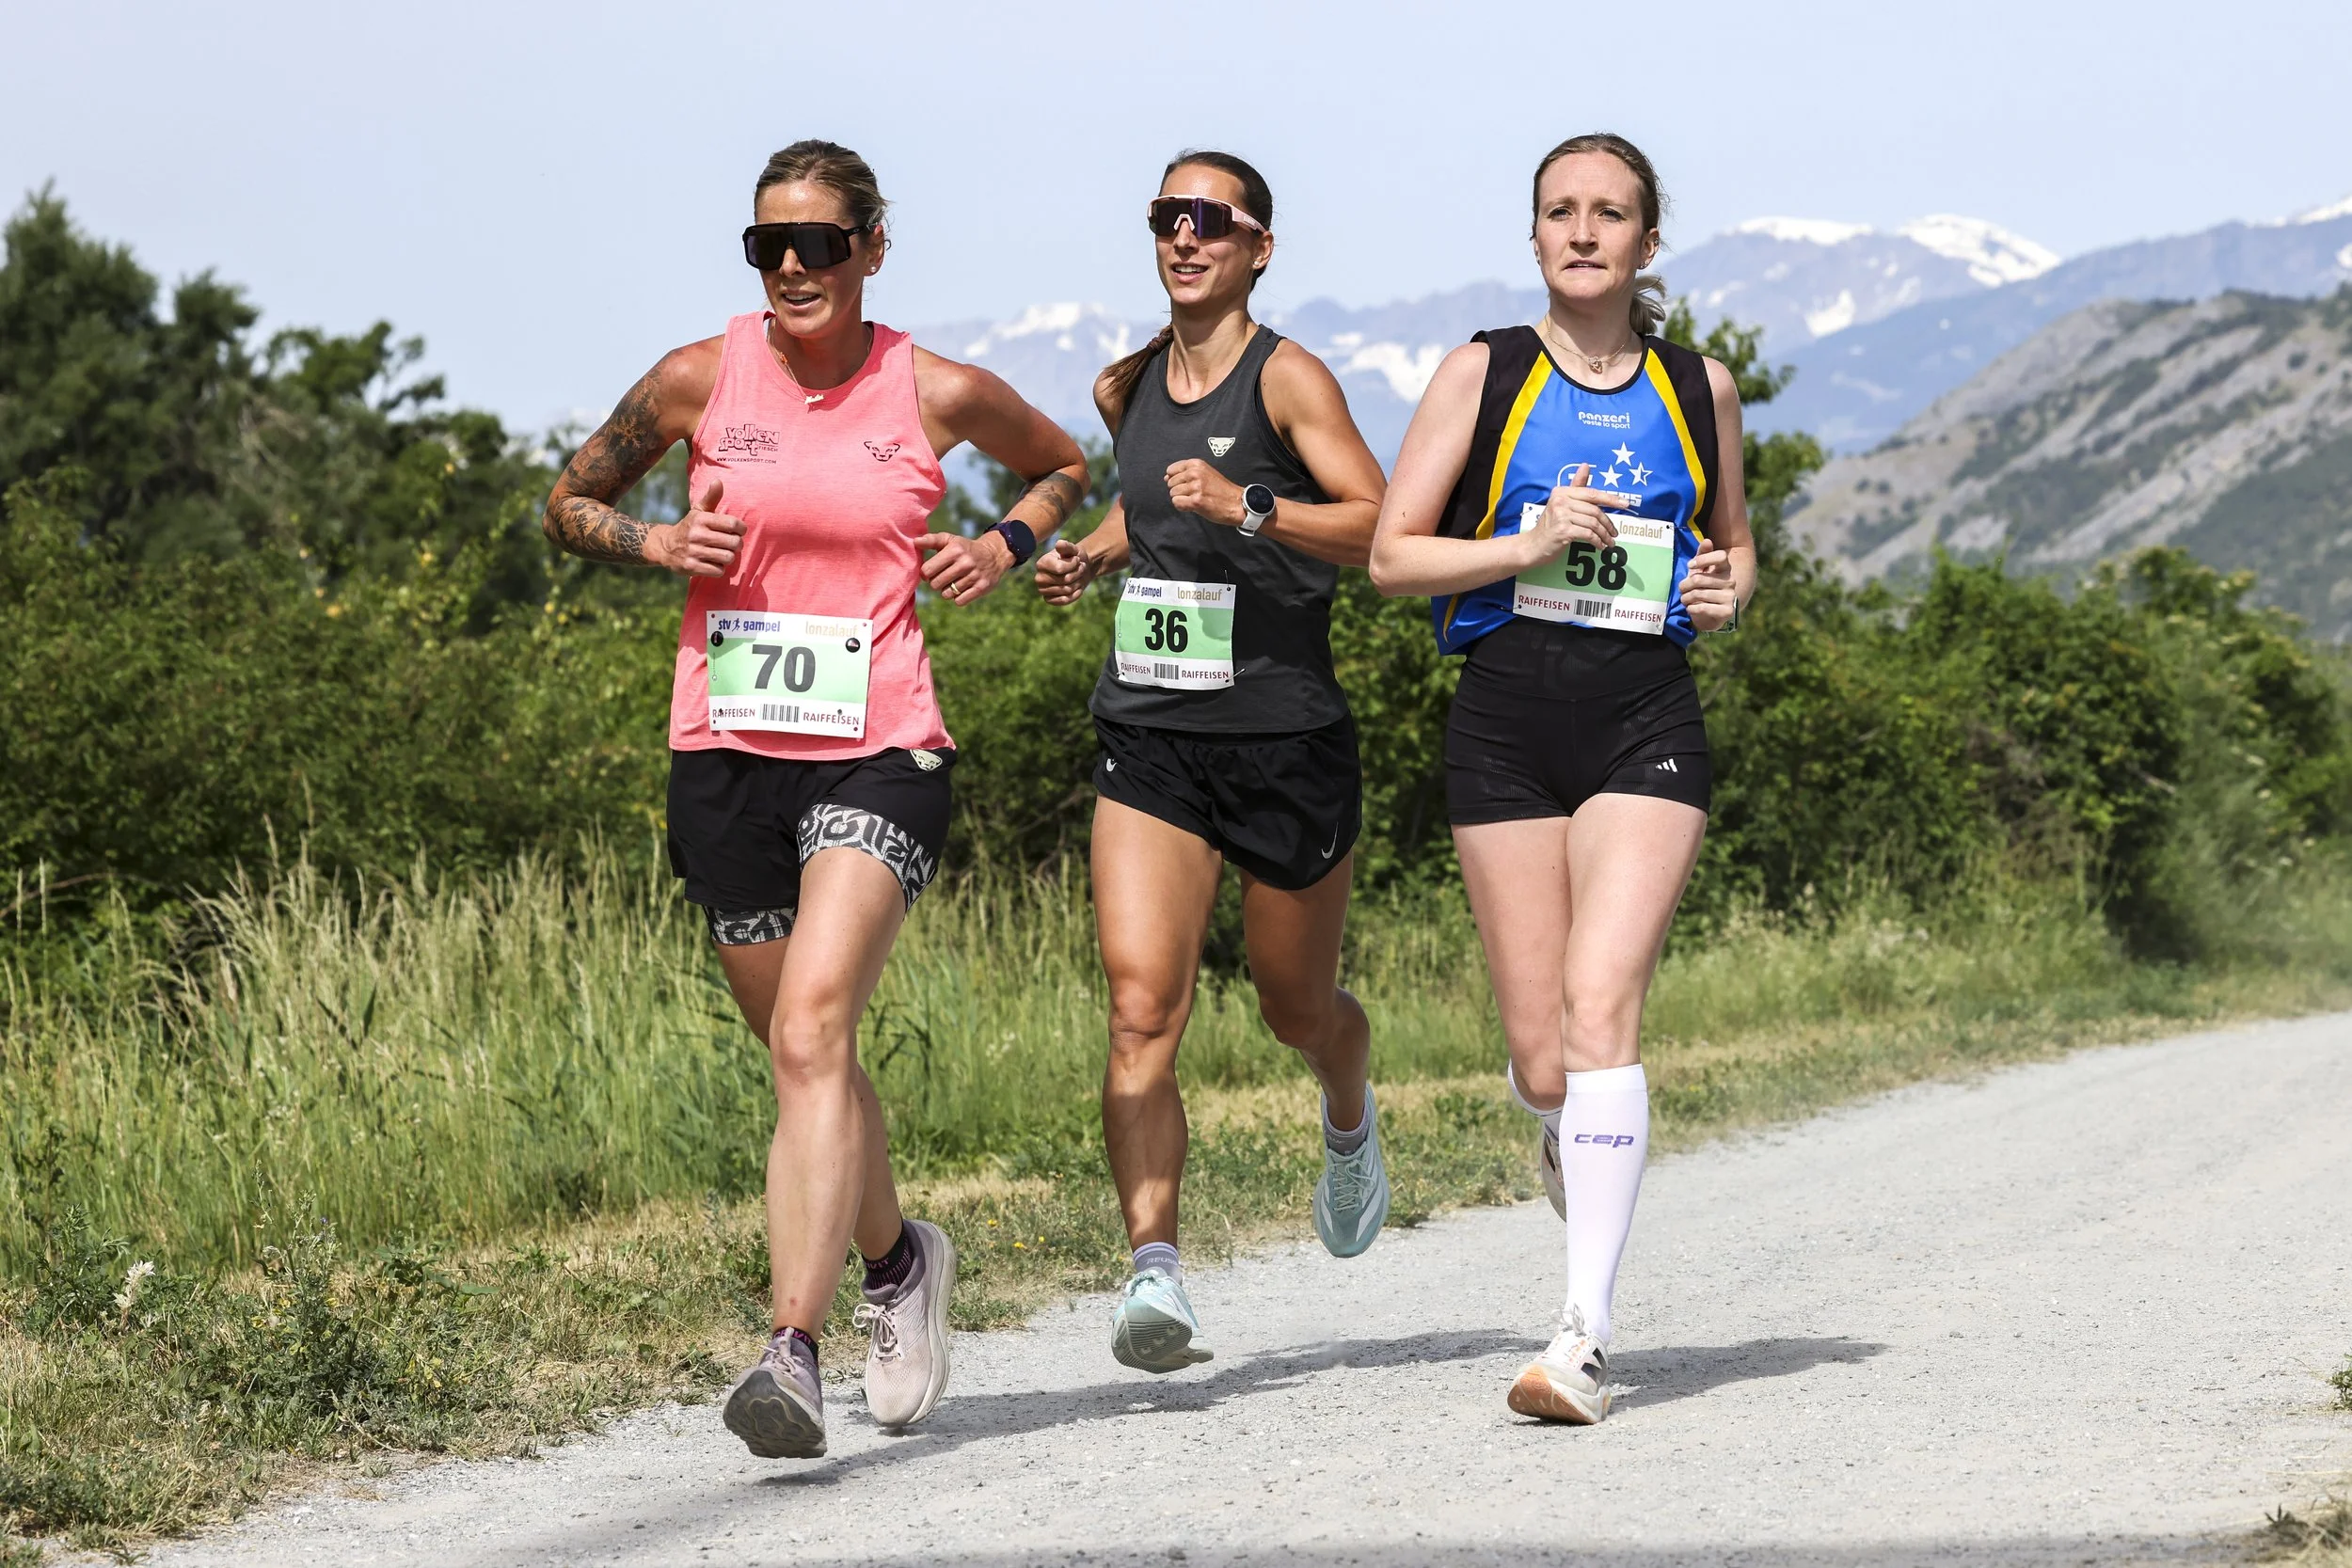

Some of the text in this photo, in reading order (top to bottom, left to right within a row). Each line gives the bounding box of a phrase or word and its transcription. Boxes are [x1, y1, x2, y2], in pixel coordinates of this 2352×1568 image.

[1578, 411, 1630, 423] panzeri
[1619, 521, 1663, 540] lonzalauf
[1565, 541, 1629, 591] 58
[1141, 586, 1162, 598] gampel
[1177, 586, 1223, 601] lonzalauf
[1518, 594, 1570, 611] RAIFFEISEN
[1614, 609, 1662, 623] RAIFFEISEN
[718, 618, 781, 632] stv gampel
[805, 621, 858, 638] lonzalauf
[1144, 608, 1188, 653] 36
[752, 643, 816, 693] 70
[1120, 662, 1152, 674] RAIFFEISEN
[1182, 670, 1229, 679] RAIFFEISEN
[803, 712, 860, 725] RAIFFEISEN
[1574, 1133, 1634, 1148] cep
